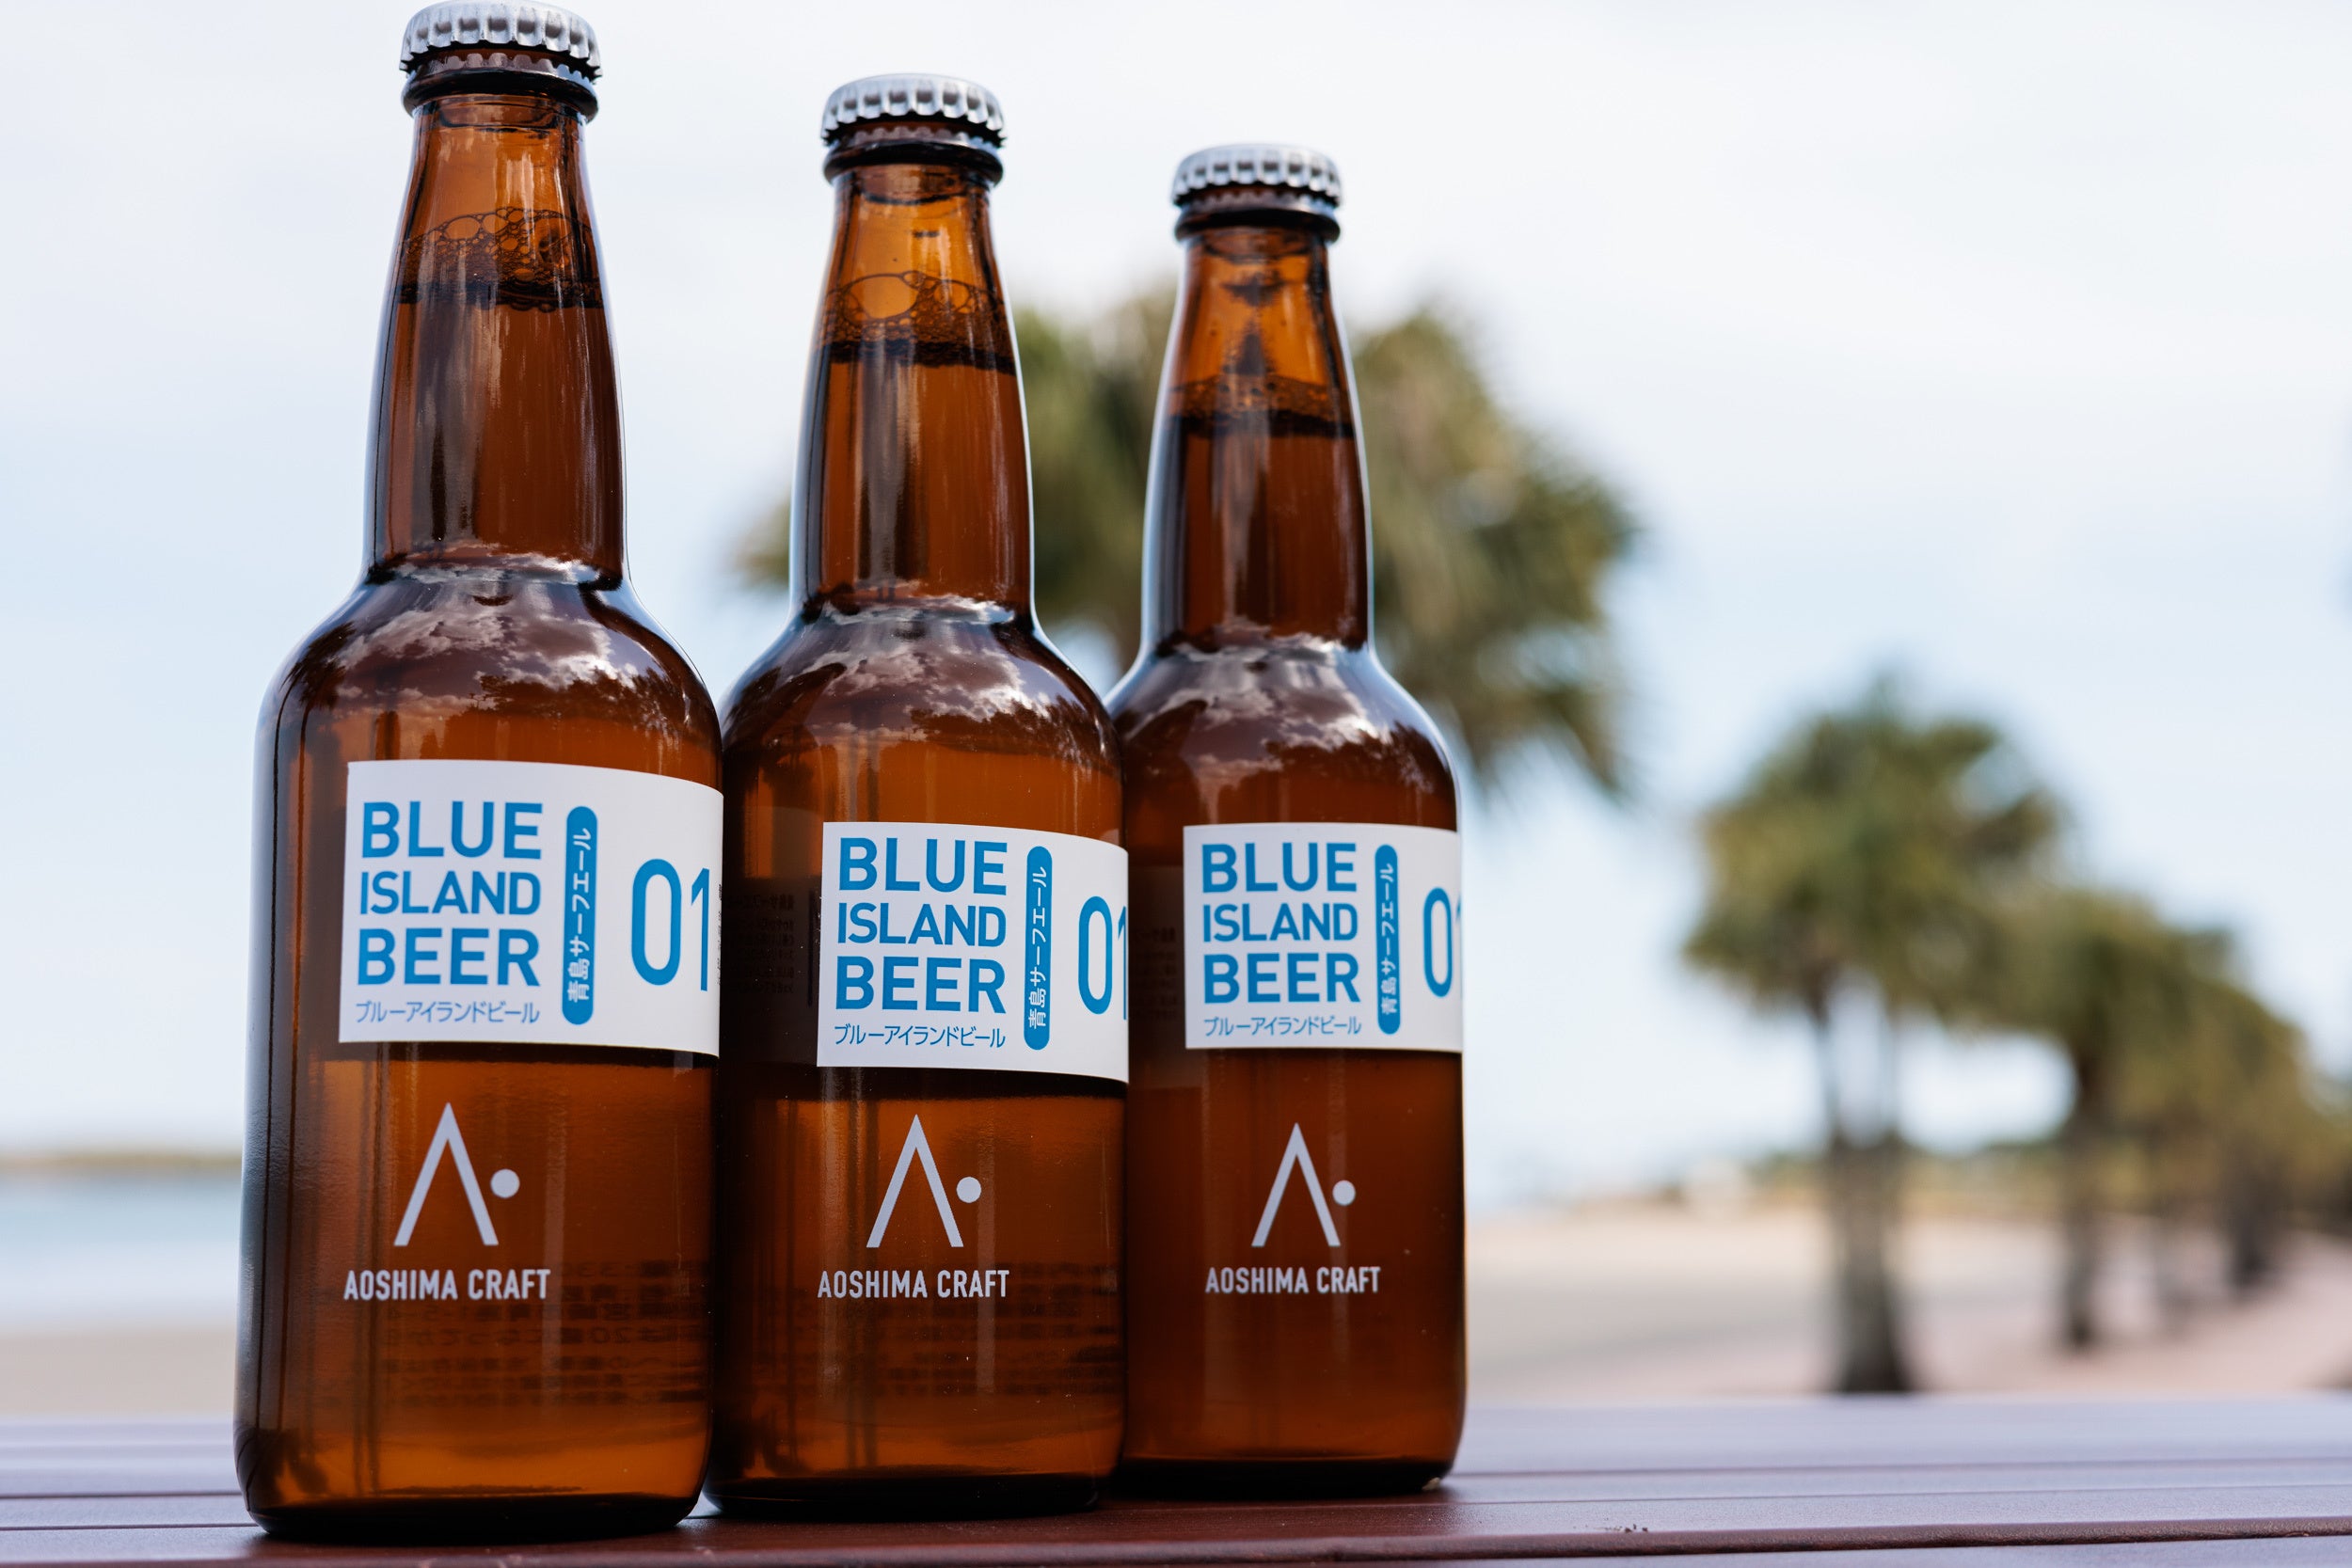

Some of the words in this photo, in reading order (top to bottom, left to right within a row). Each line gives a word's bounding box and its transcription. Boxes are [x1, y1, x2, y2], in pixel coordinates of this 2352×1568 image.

[361, 800, 544, 861] BLUE
[359, 869, 542, 916] ISLAND
[838, 836, 1008, 896] BLUE
[1201, 842, 1358, 894] BLUE
[567, 828, 592, 1004] 青島サーフエール
[630, 858, 711, 992] 01
[837, 902, 1007, 948] ISLAND
[1202, 902, 1359, 943] ISLAND
[1380, 863, 1398, 1014] 青島サーフエール
[1422, 887, 1461, 998] 0
[357, 927, 541, 988] BEER
[1028, 866, 1047, 1029] 青島サーフエール
[1078, 895, 1127, 1021] 01
[835, 955, 1007, 1015] BEER
[1203, 952, 1361, 1005] BEER
[356, 1001, 541, 1024] ブルーアイランドビール
[834, 1023, 1006, 1049] ブルーアイランドビール
[1204, 1015, 1362, 1037] ブルーアイランドビール
[343, 1270, 458, 1301] AOSHIMA
[468, 1269, 551, 1300] CRAFT
[818, 1270, 928, 1299] AOSHIMA
[937, 1270, 1009, 1298] CRAFT
[1205, 1267, 1309, 1294] AOSHIMA
[1317, 1267, 1380, 1294] CRAFT
